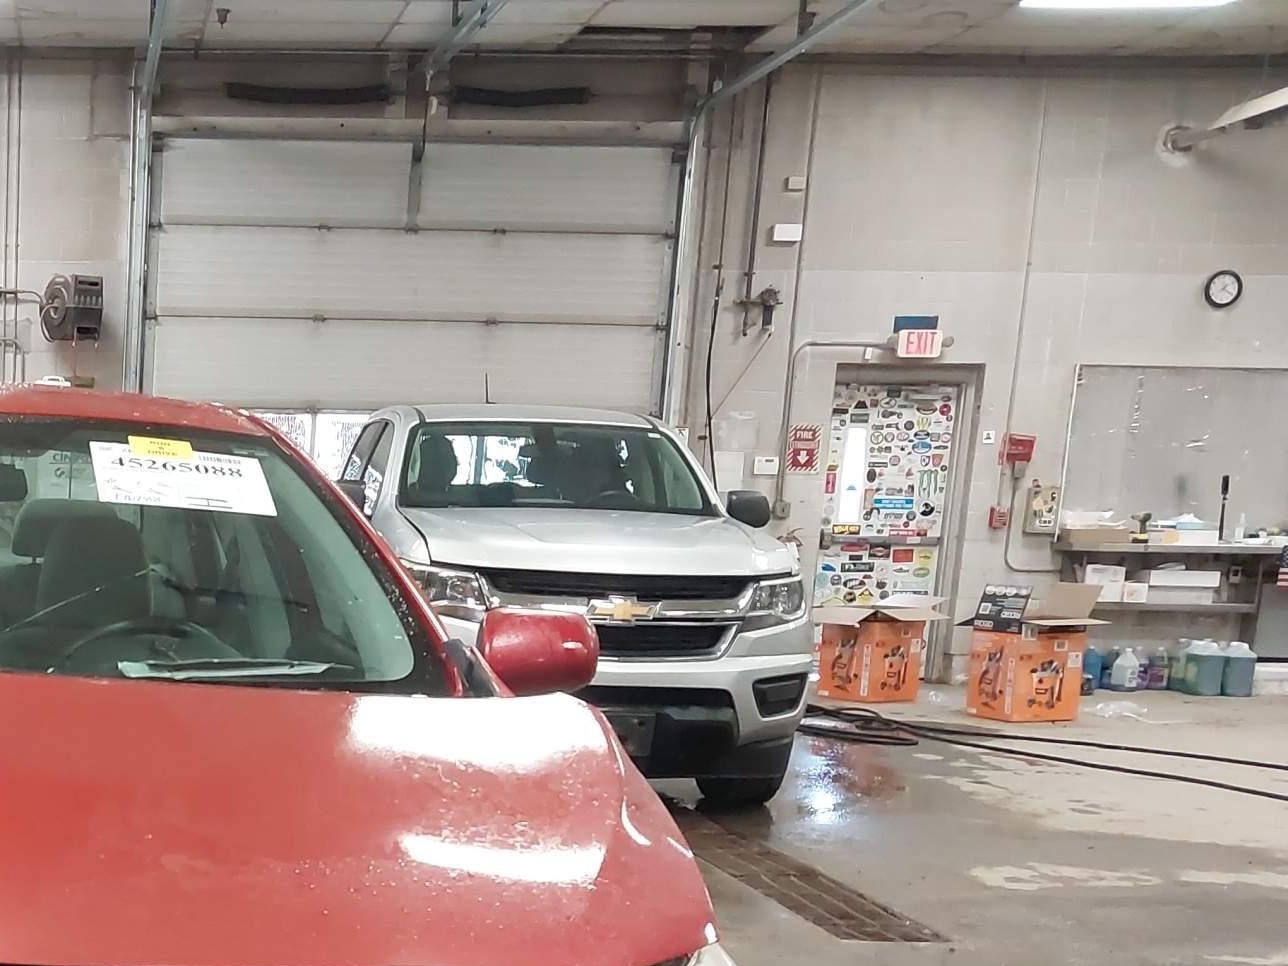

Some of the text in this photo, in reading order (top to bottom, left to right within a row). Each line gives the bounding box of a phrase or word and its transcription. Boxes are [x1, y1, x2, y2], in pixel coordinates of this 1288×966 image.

[905, 331, 938, 355] EXIT
[796, 430, 814, 440] FIRE
[110, 456, 244, 478] 45265088
